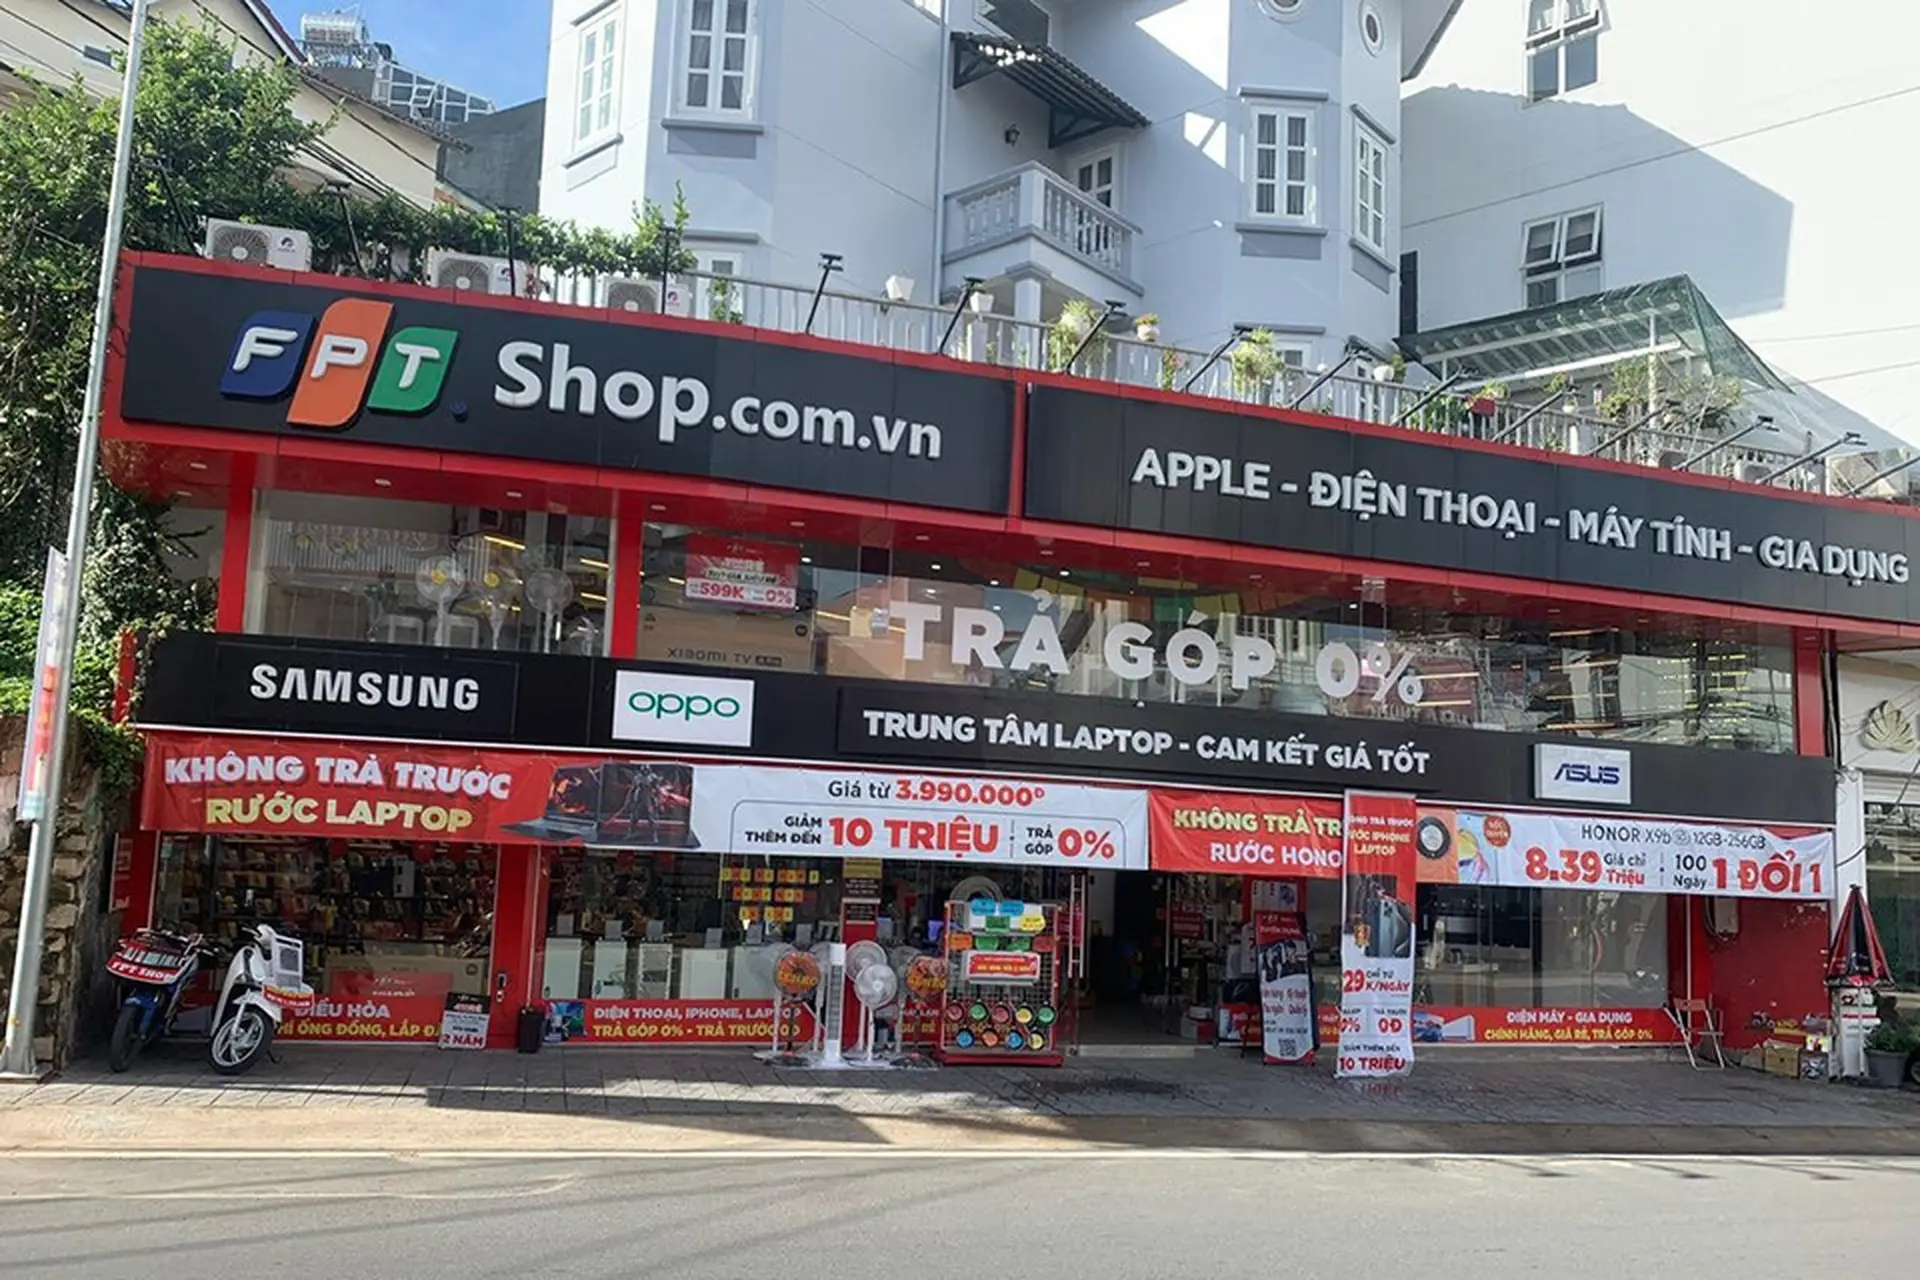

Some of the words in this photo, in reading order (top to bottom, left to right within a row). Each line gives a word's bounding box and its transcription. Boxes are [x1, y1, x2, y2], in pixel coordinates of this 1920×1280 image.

[232, 326, 441, 390] FPT
[494, 341, 942, 459] Shop.com.vn
[1132, 448, 1271, 499] APPLE
[1280, 481, 1298, 494] -
[1308, 469, 1407, 521] ĐIỆN
[1416, 487, 1536, 538] THOẠI
[1544, 517, 1561, 528] -
[1569, 505, 1643, 548] MÁY
[1650, 515, 1731, 561] TÍNH
[1737, 545, 1753, 555] -
[1760, 535, 1818, 573] GIA
[1822, 545, 1909, 587] DỤNG
[734, 653, 752, 664] TV
[889, 589, 1070, 676] TRẢ
[1104, 610, 1275, 690] GÓP
[1316, 642, 1424, 705] 0%
[249, 663, 480, 711] SAMSUNG
[628, 691, 740, 721] oppo
[863, 709, 976, 743] TRUNG
[984, 712, 1048, 748] TÂM
[1054, 724, 1173, 755] LAPTOP
[1196, 735, 1259, 763] CAM
[1266, 730, 1318, 767] KẾT
[1325, 744, 1372, 770] GIÁ
[1378, 744, 1430, 774] TỐT
[165, 751, 304, 784] KHÔNG
[394, 762, 512, 799] TRƯỚC
[1553, 762, 1620, 785] ASUS
[828, 779, 862, 799] Giá
[869, 780, 891, 799] từ
[206, 791, 318, 824] RƯỚC
[326, 799, 473, 833] LAPTOP
[785, 814, 823, 828] GIẢM
[1174, 806, 1258, 833] KHÔNG
[1263, 809, 1311, 835] TRẢ
[745, 829, 787, 844] THÊM
[790, 829, 823, 845] ĐẾN
[829, 818, 872, 847] 10
[884, 815, 998, 857] TRIỆU
[1026, 823, 1053, 839] TRẢ
[1582, 824, 1640, 847] HONOR
[1025, 839, 1053, 855] GÓP
[1058, 829, 1114, 859] 0%
[1210, 840, 1274, 864] RƯỚC
[1282, 847, 1344, 867] HONO
[1525, 846, 1601, 883] 8.39
[1603, 852, 1625, 866] Giá
[1627, 852, 1647, 867] chỉ
[1675, 854, 1707, 871] 100
[1712, 858, 1727, 889] 1
[1737, 849, 1802, 892] ĐỔI
[1810, 863, 1822, 893] 1
[1605, 868, 1646, 888] Triệu
[1673, 875, 1707, 890] Ngày
[1344, 969, 1365, 992] 29
[594, 1005, 629, 1021] ĐIỆN
[632, 1007, 682, 1021] THOẠI,
[685, 1007, 742, 1021] IPHONE,
[1506, 1011, 1537, 1025] ĐIỆN
[1539, 1010, 1565, 1024] MÁY
[1575, 1012, 1596, 1024] GIA
[1598, 1012, 1632, 1026] DỤNG
[593, 1023, 622, 1037] TRẢ
[626, 1023, 658, 1037] GÓP
[660, 1025, 684, 1037] 0%
[696, 1023, 725, 1037] TRẢ
[1554, 1027, 1573, 1040] GIÁ
[1591, 1028, 1613, 1040] TRẢ
[1615, 1027, 1636, 1040] GÓP
[1637, 1029, 1653, 1040] 0%
[1340, 1058, 1355, 1070] 10
[1358, 1055, 1405, 1072] TRIỆU
